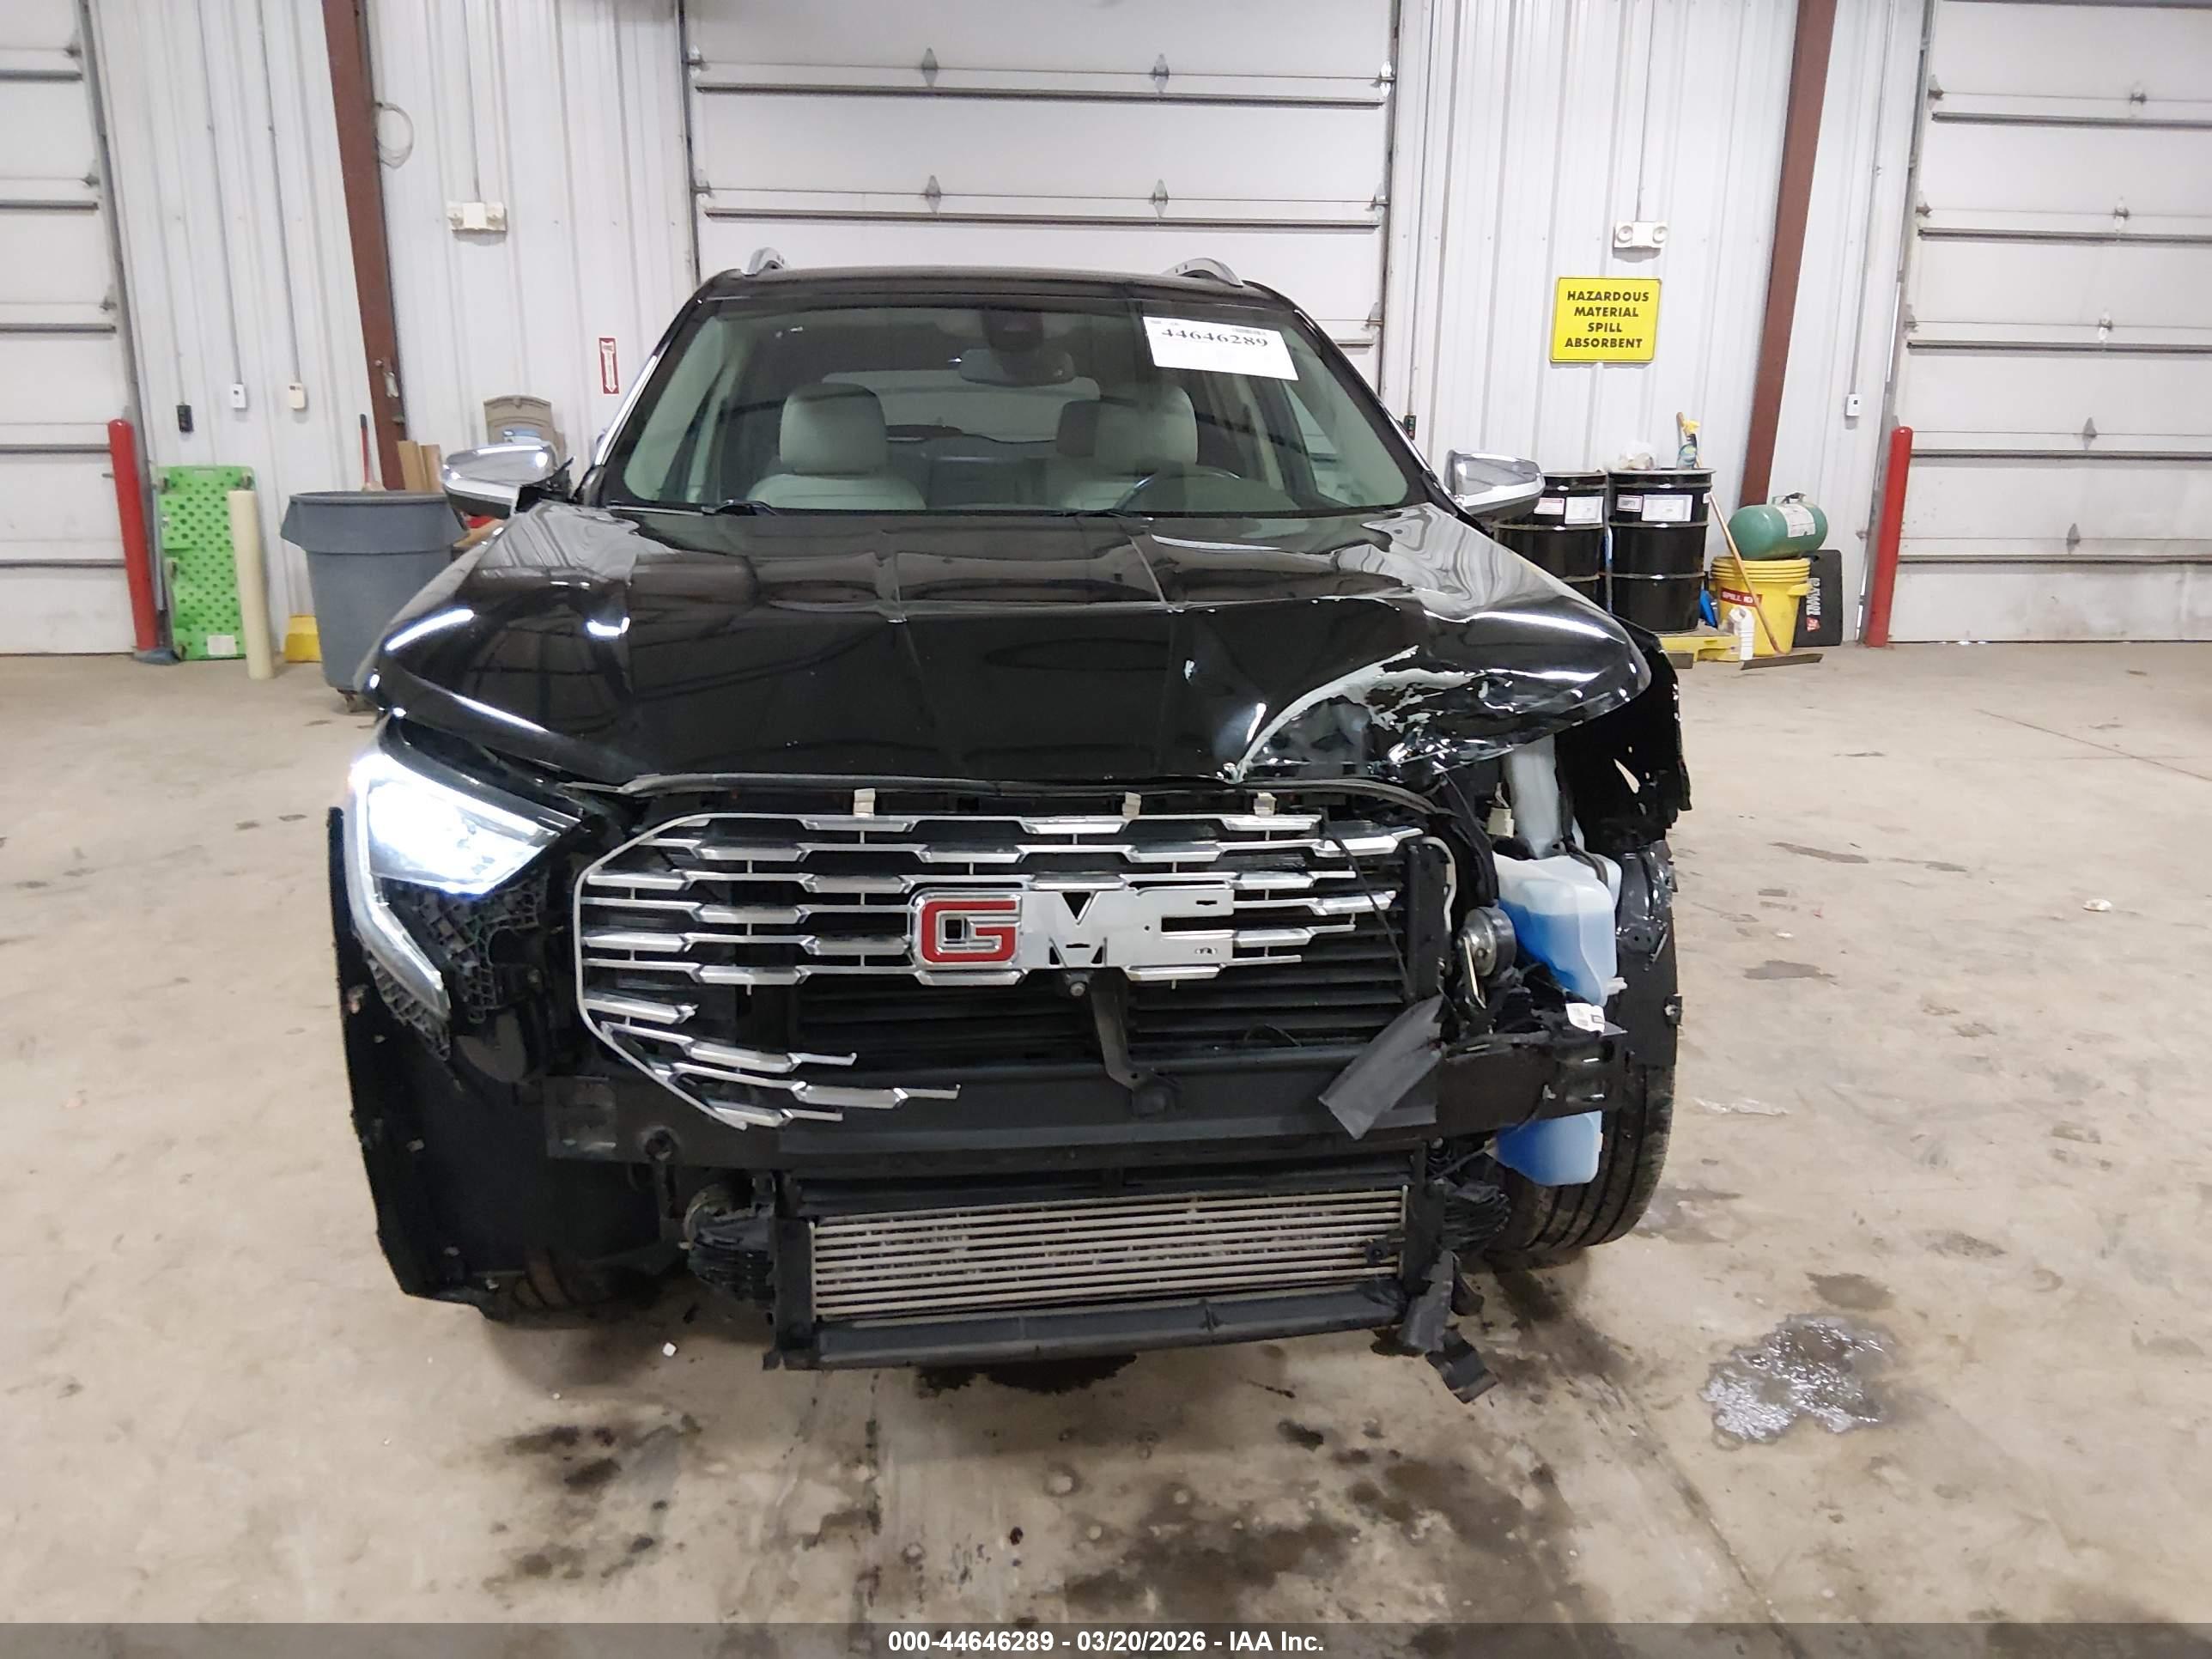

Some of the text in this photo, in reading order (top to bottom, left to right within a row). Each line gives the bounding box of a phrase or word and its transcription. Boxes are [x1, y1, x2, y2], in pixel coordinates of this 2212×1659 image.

[1567, 290, 1650, 302] HAZARDOUS
[1574, 307, 1638, 318] MATERIAL
[1587, 322, 1623, 333] SPILL
[1161, 328, 1268, 348] 44646289
[1565, 337, 1643, 349] ABSORBENT
[911, 889, 1234, 970] GMC
